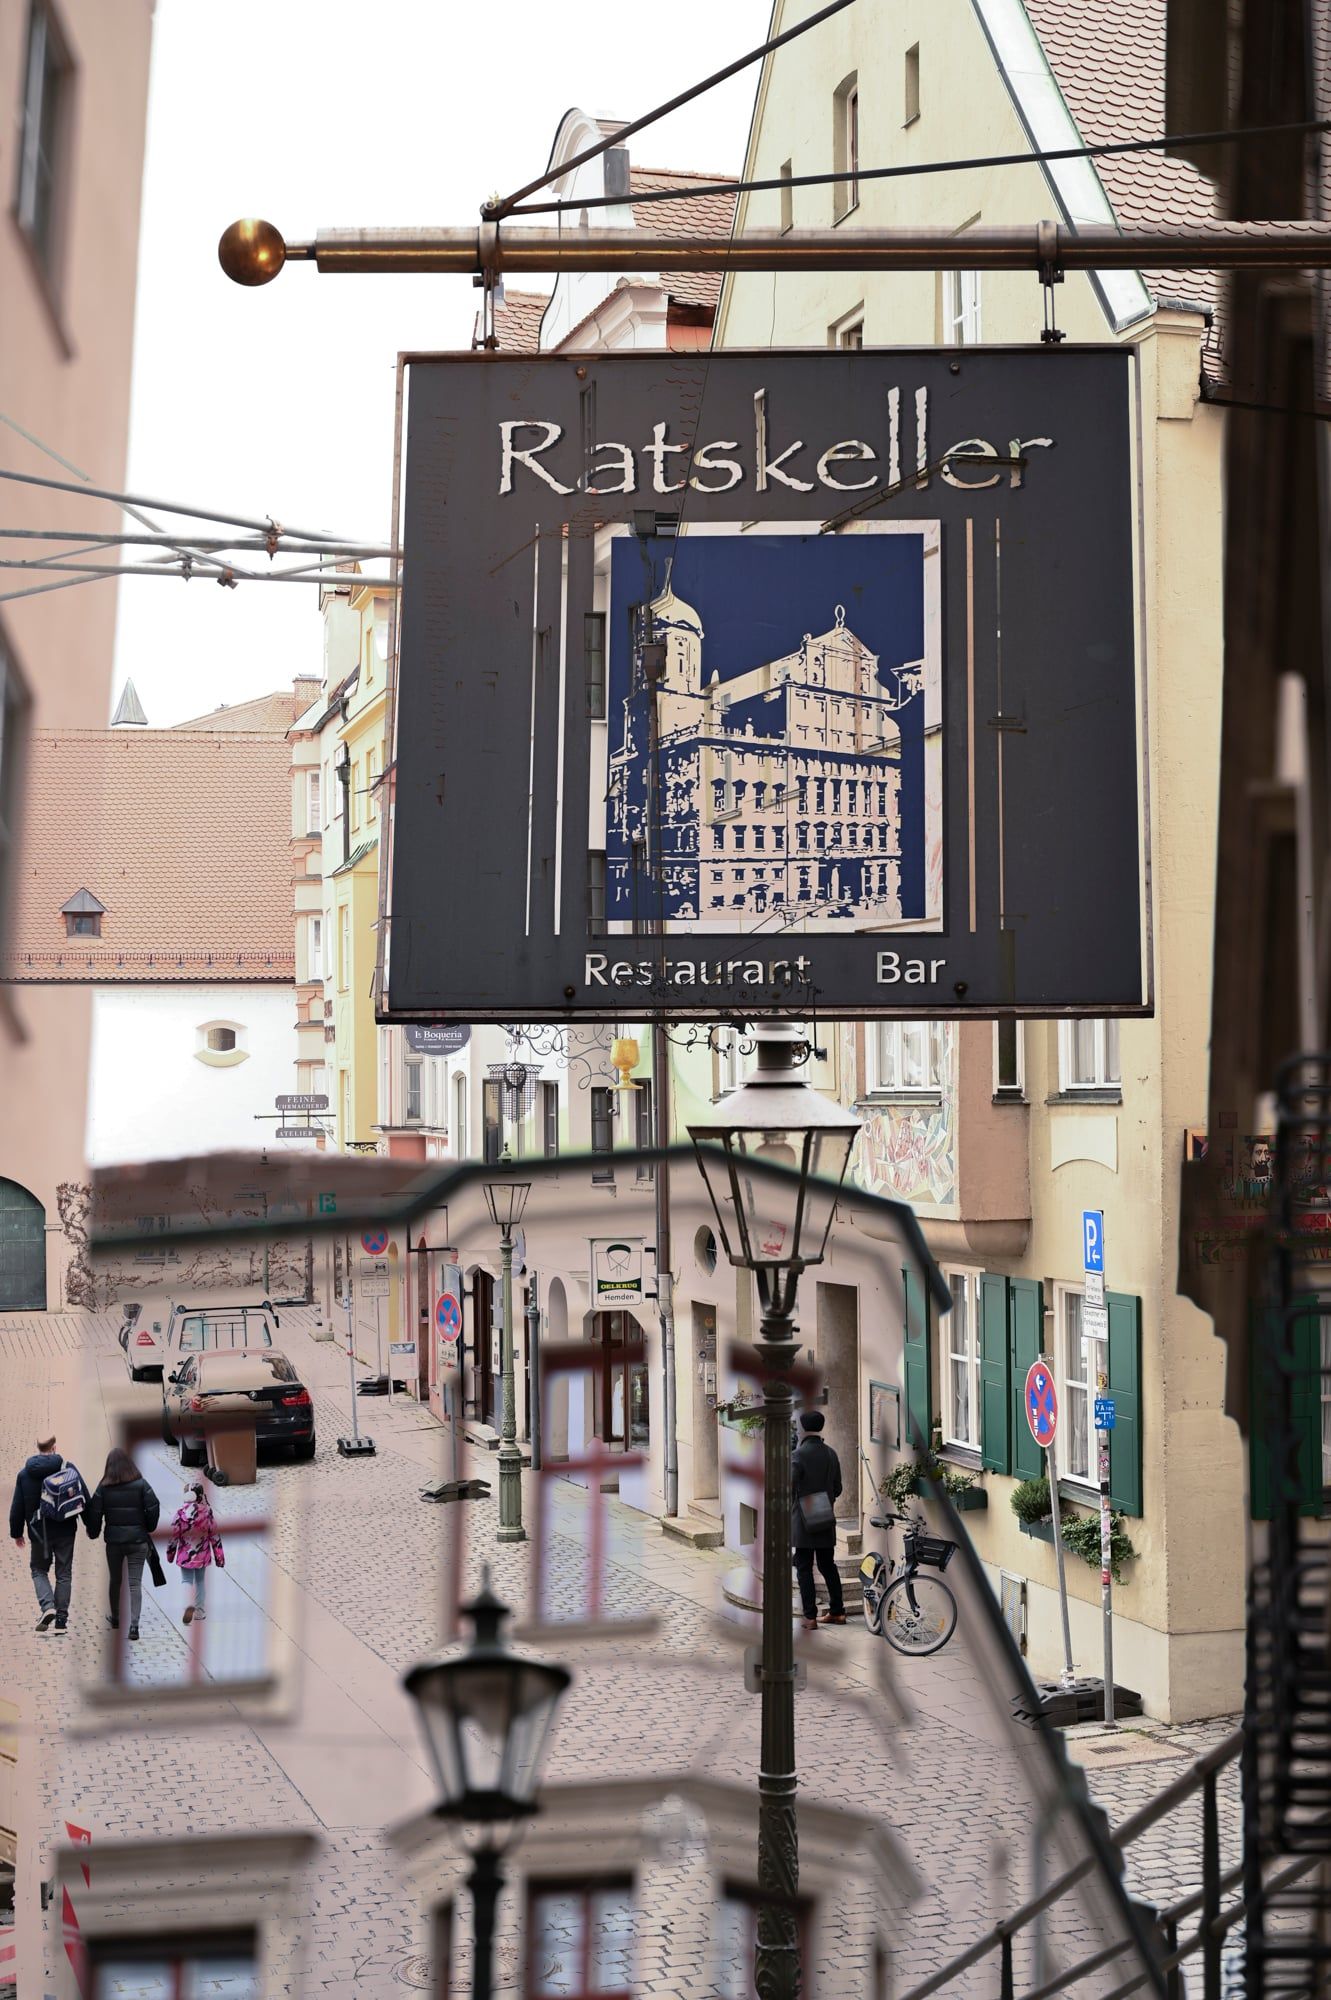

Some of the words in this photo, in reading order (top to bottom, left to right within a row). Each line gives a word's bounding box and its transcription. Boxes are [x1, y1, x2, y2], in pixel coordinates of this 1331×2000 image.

[498, 385, 1053, 495] Ratskeller
[584, 952, 812, 987] Restaurant
[876, 951, 947, 985] Bar
[423, 1030, 463, 1042] Boqueria
[287, 1096, 317, 1104] FEINE
[278, 1130, 314, 1138] ATELIER
[1085, 1218, 1098, 1263] P
[600, 1282, 638, 1290] OELKRUG
[604, 1293, 635, 1302] Hemden
